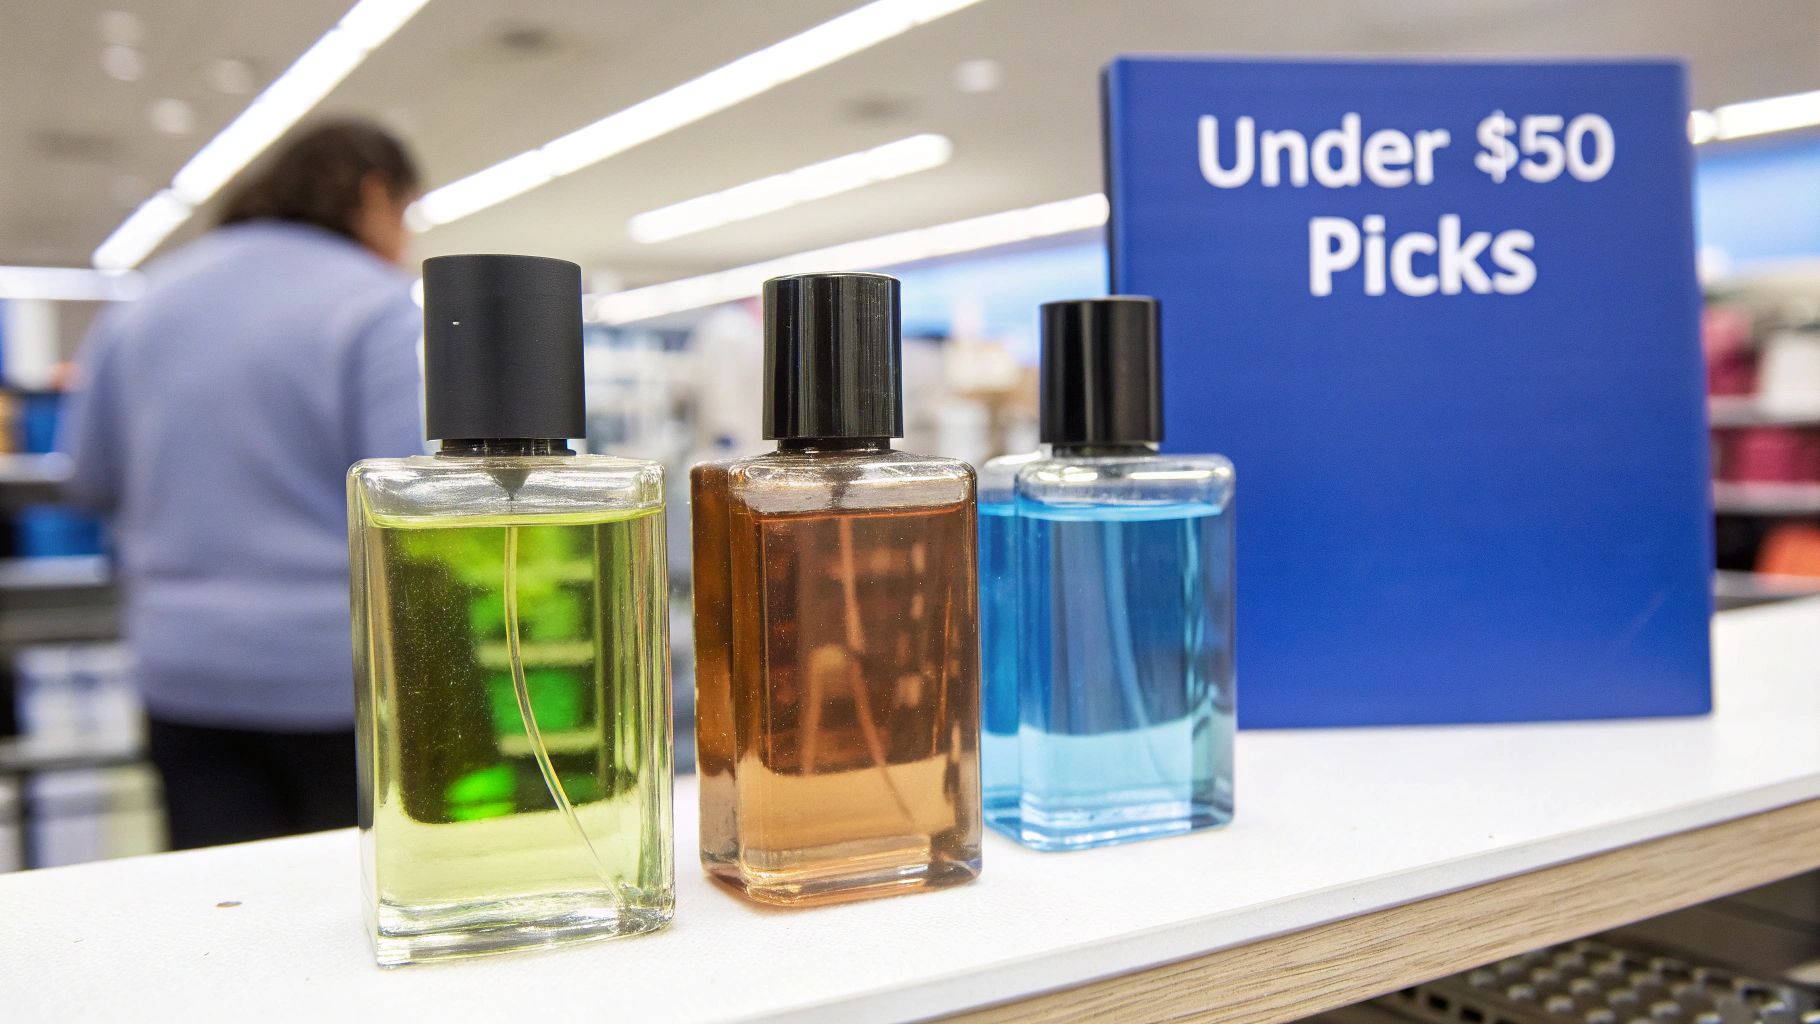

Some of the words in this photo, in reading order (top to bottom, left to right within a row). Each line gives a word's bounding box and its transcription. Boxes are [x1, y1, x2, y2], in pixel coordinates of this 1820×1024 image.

[1197, 112, 1451, 189] Under
[1474, 110, 1615, 184] $50
[1308, 213, 1537, 298] Picks
